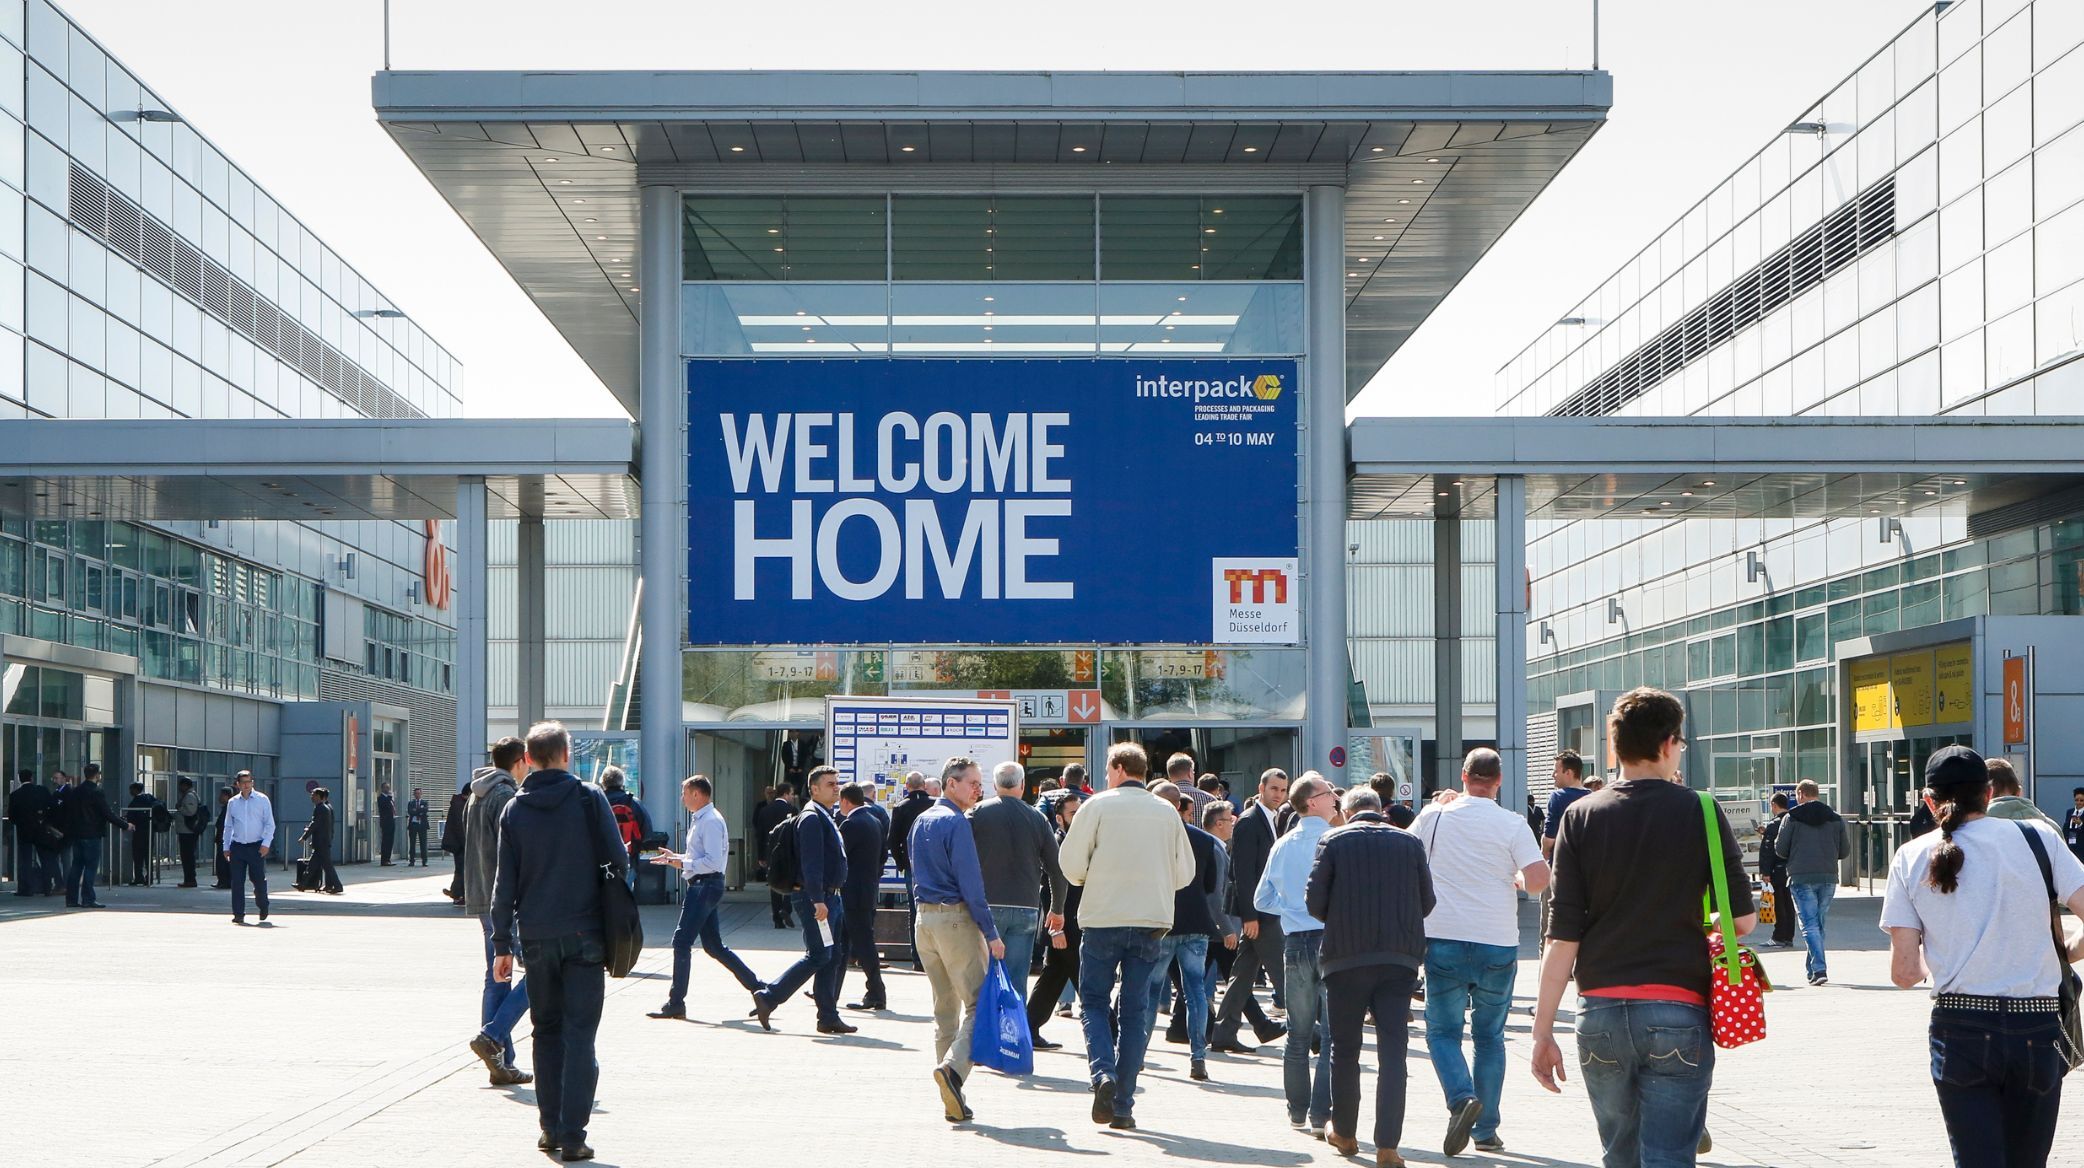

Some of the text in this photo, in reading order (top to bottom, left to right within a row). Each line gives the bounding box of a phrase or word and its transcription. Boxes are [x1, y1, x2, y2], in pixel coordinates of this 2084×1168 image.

[1136, 374, 1254, 403] interpack
[1194, 405, 1275, 413] PROCESSES AND PACKAGING
[1194, 413, 1253, 421] LEADING TRADE FAIR
[1194, 432, 1213, 446] 04
[1228, 432, 1243, 446] 10
[1246, 432, 1275, 446] MAY
[719, 411, 1072, 494] WELCOME
[733, 498, 1075, 601] HOME
[1229, 608, 1262, 619] Messe
[1229, 621, 1288, 633] Düsseldorf
